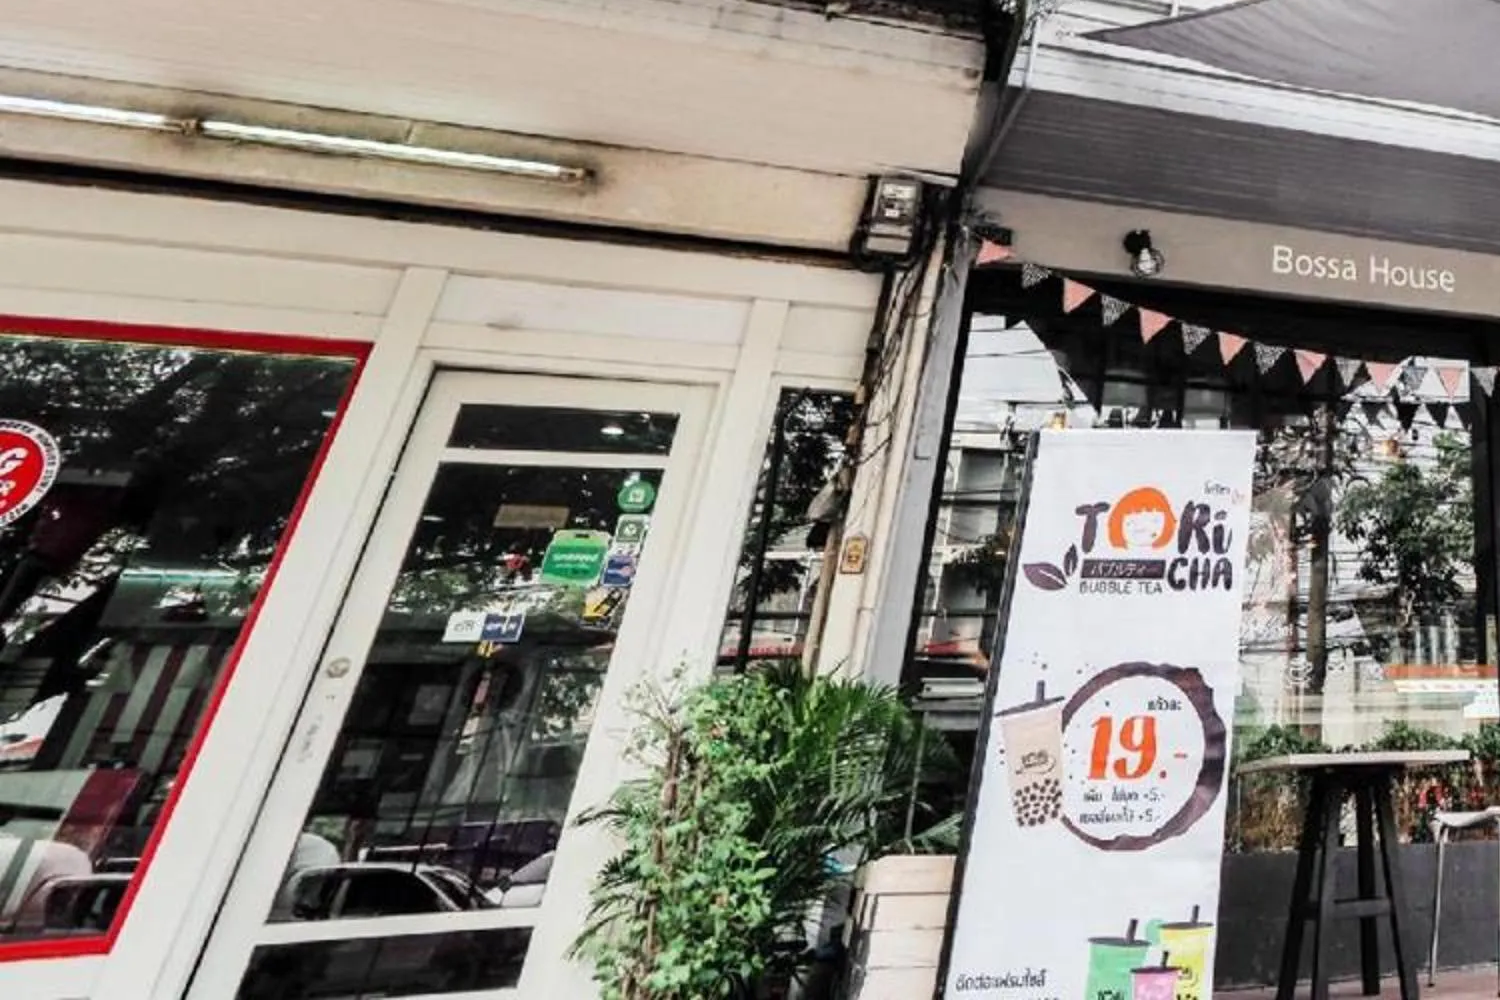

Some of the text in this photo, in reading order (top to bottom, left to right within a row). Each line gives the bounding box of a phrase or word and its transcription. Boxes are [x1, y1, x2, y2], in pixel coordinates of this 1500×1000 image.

[1271, 244, 1456, 294] Bossa House
[1079, 581, 1163, 595] BUBBLE TEA
[1167, 556, 1233, 592] CHA
